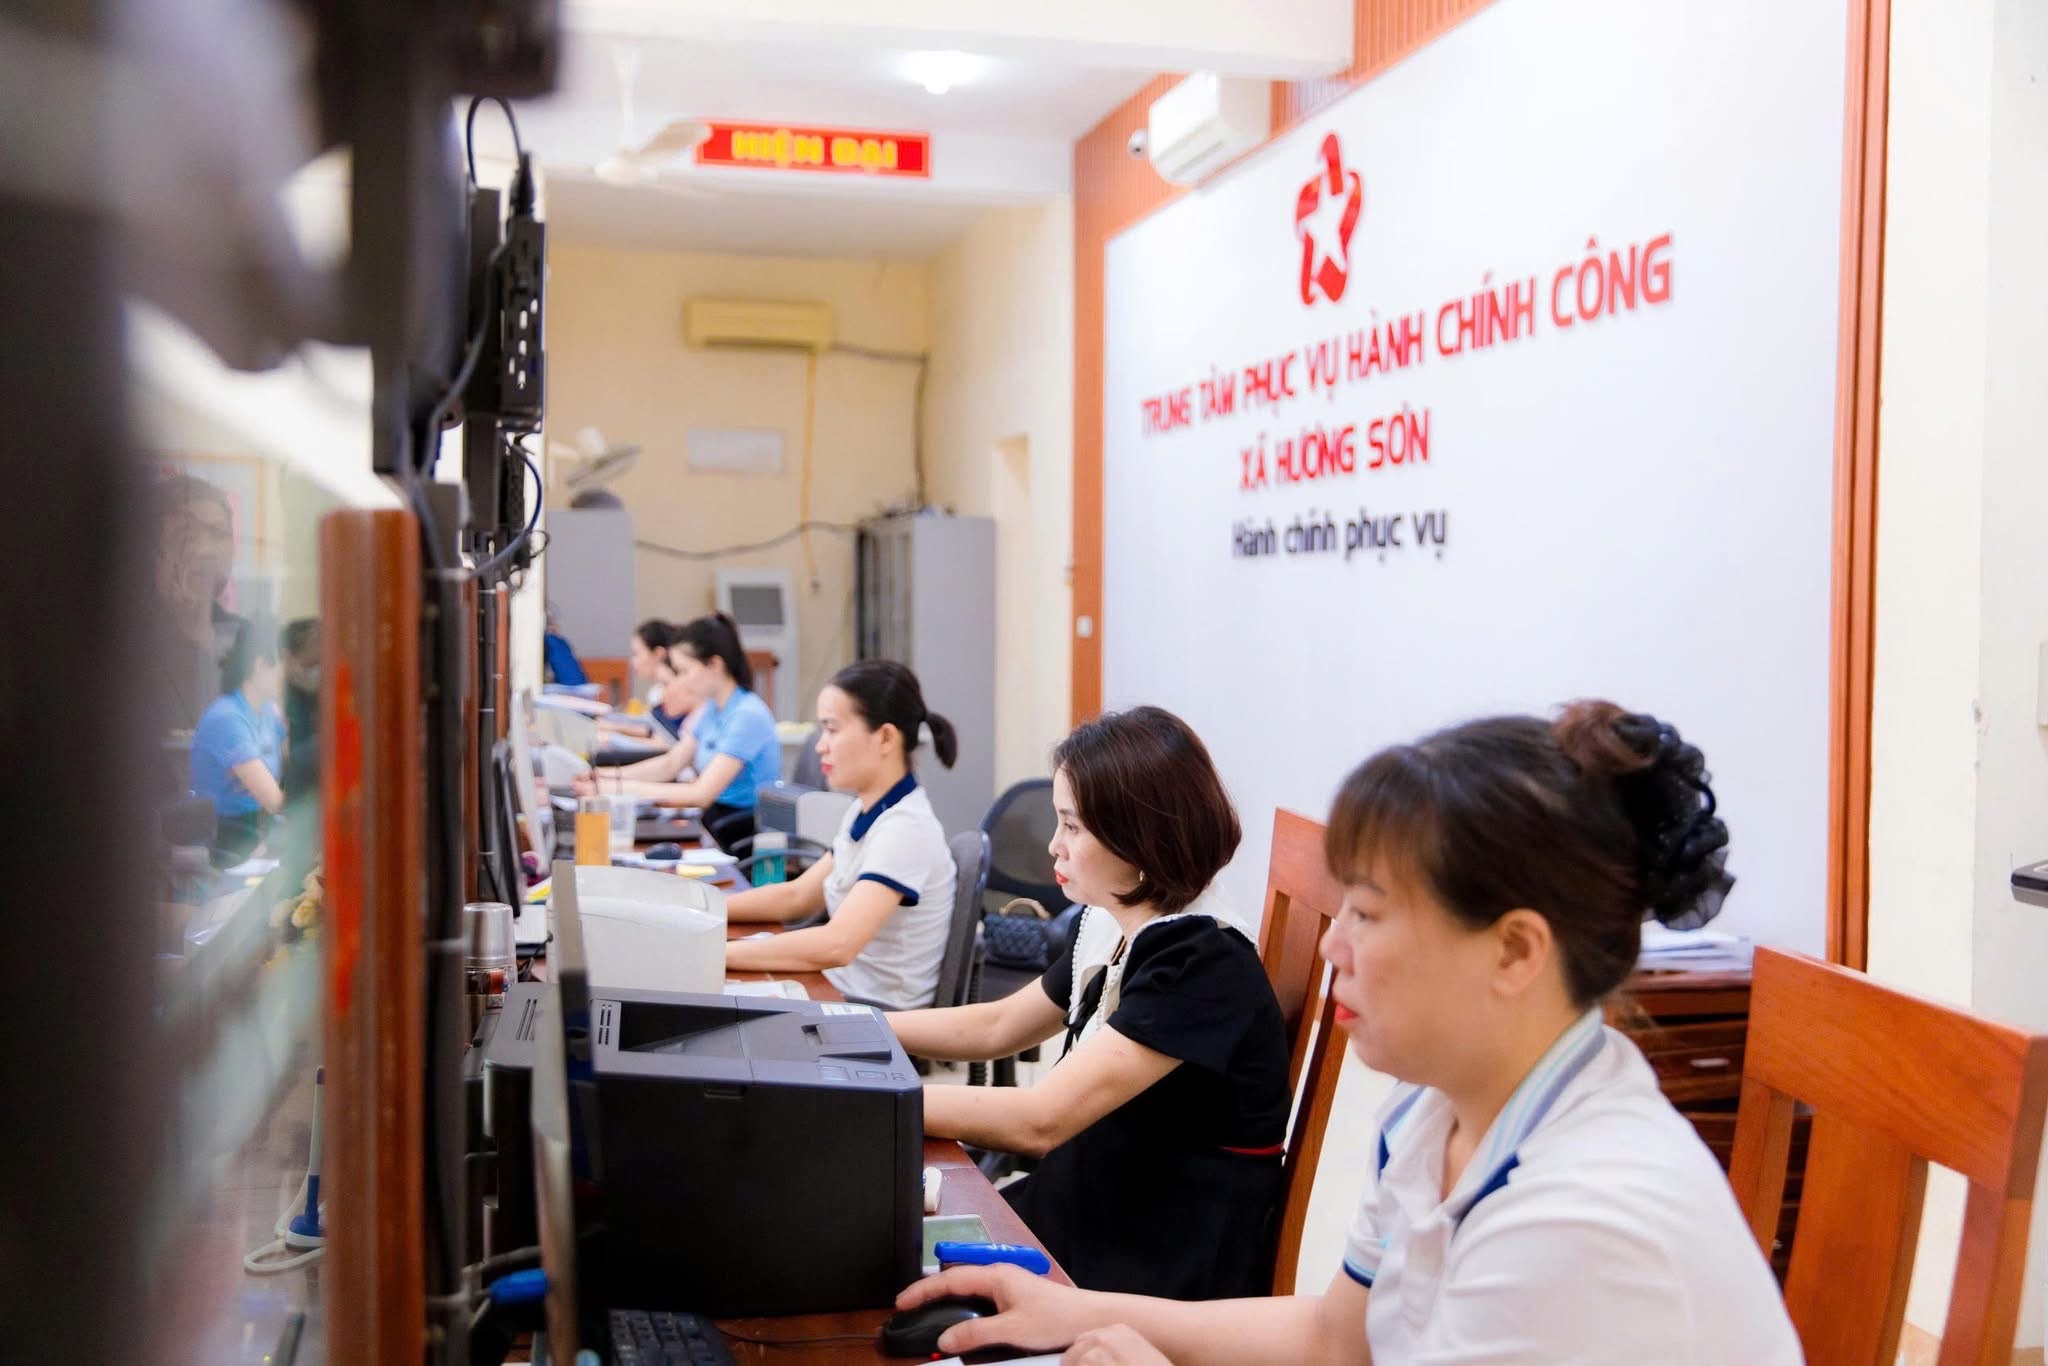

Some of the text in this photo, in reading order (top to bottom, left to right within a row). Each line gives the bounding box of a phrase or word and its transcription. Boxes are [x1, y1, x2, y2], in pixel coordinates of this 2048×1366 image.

[731, 128, 824, 168] HIỆN
[1243, 351, 1297, 418] PHỤC
[1305, 335, 1340, 403] VỤ
[1346, 309, 1425, 381] HÀNH
[1435, 270, 1536, 358] CHÍNH
[1550, 233, 1673, 329] CÔNG
[1367, 402, 1431, 472] SƠN
[1232, 515, 1279, 560] Hành
[1284, 508, 1339, 556] chính
[1345, 505, 1404, 562] phục
